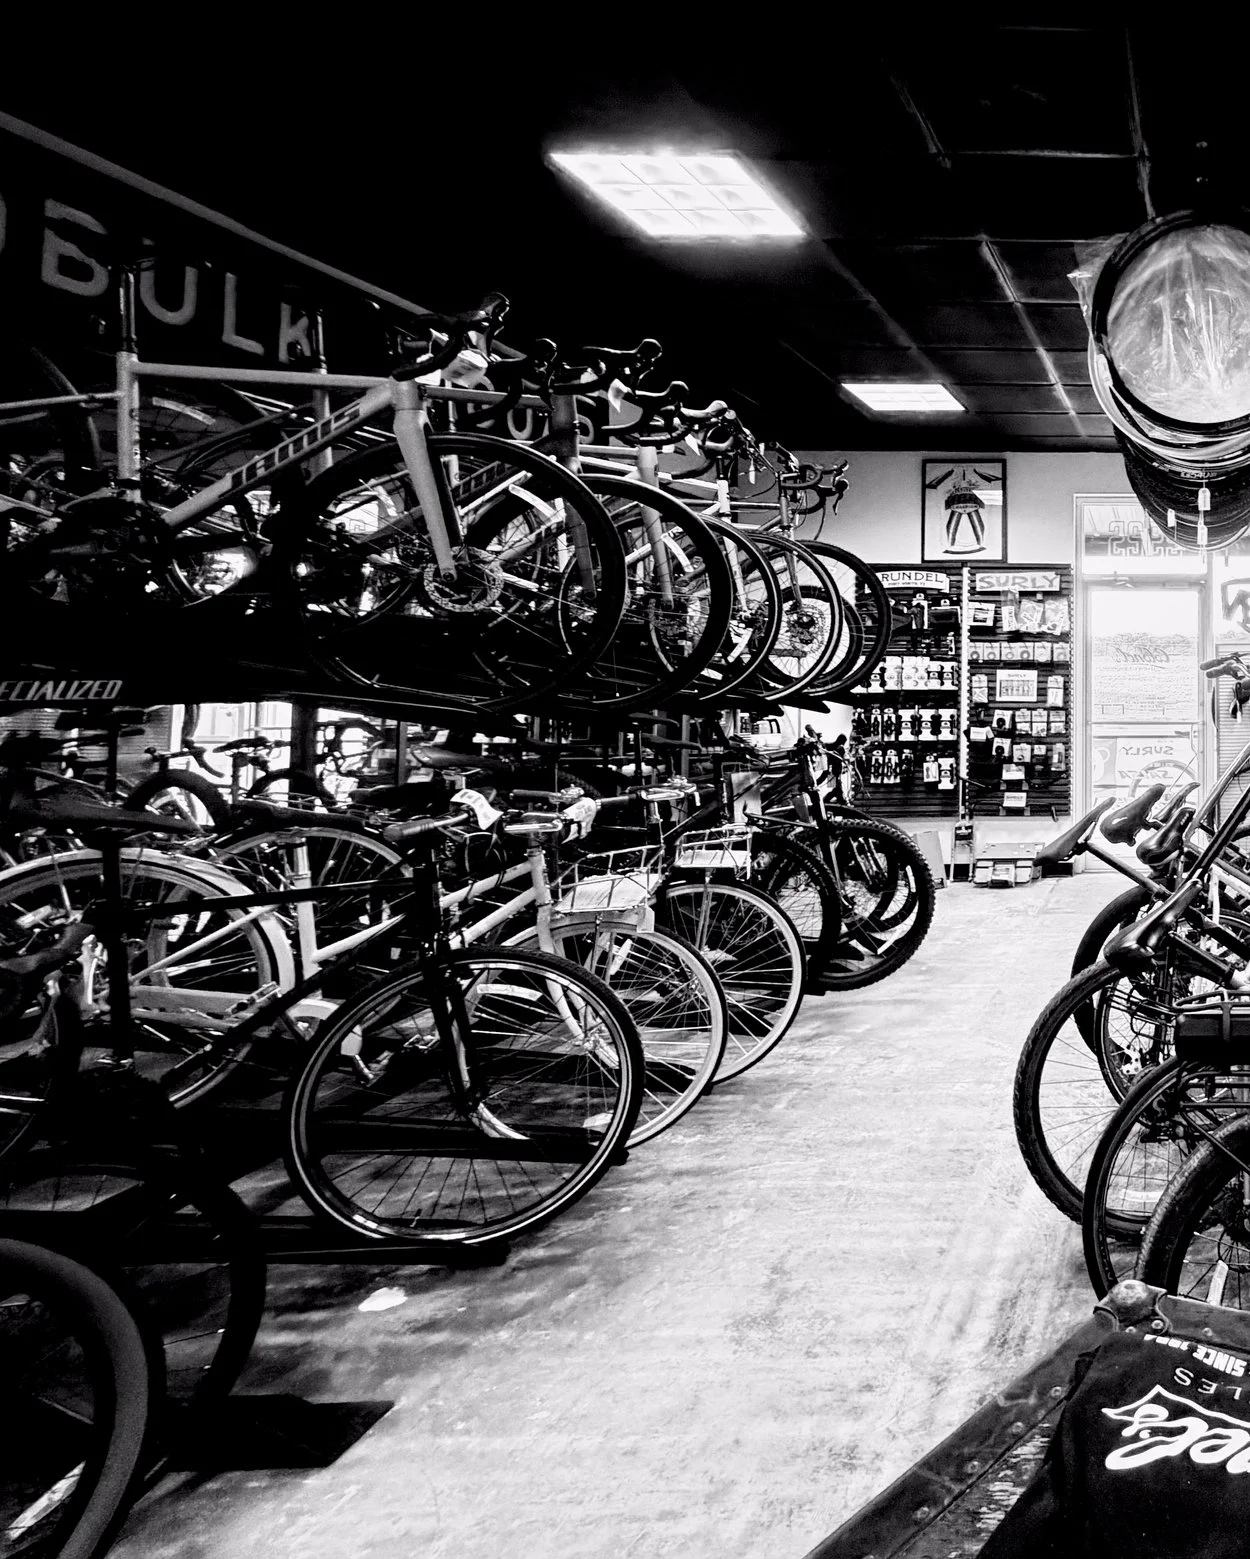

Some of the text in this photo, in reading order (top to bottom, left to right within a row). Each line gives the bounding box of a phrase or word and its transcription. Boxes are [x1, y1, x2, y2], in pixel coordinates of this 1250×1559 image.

[0, 190, 313, 364] BULK
[221, 402, 362, 499] JAMIS
[880, 571, 944, 585] RUNDEL
[978, 575, 1060, 590] SURLY
[1193, 1344, 1246, 1378] SINCE
